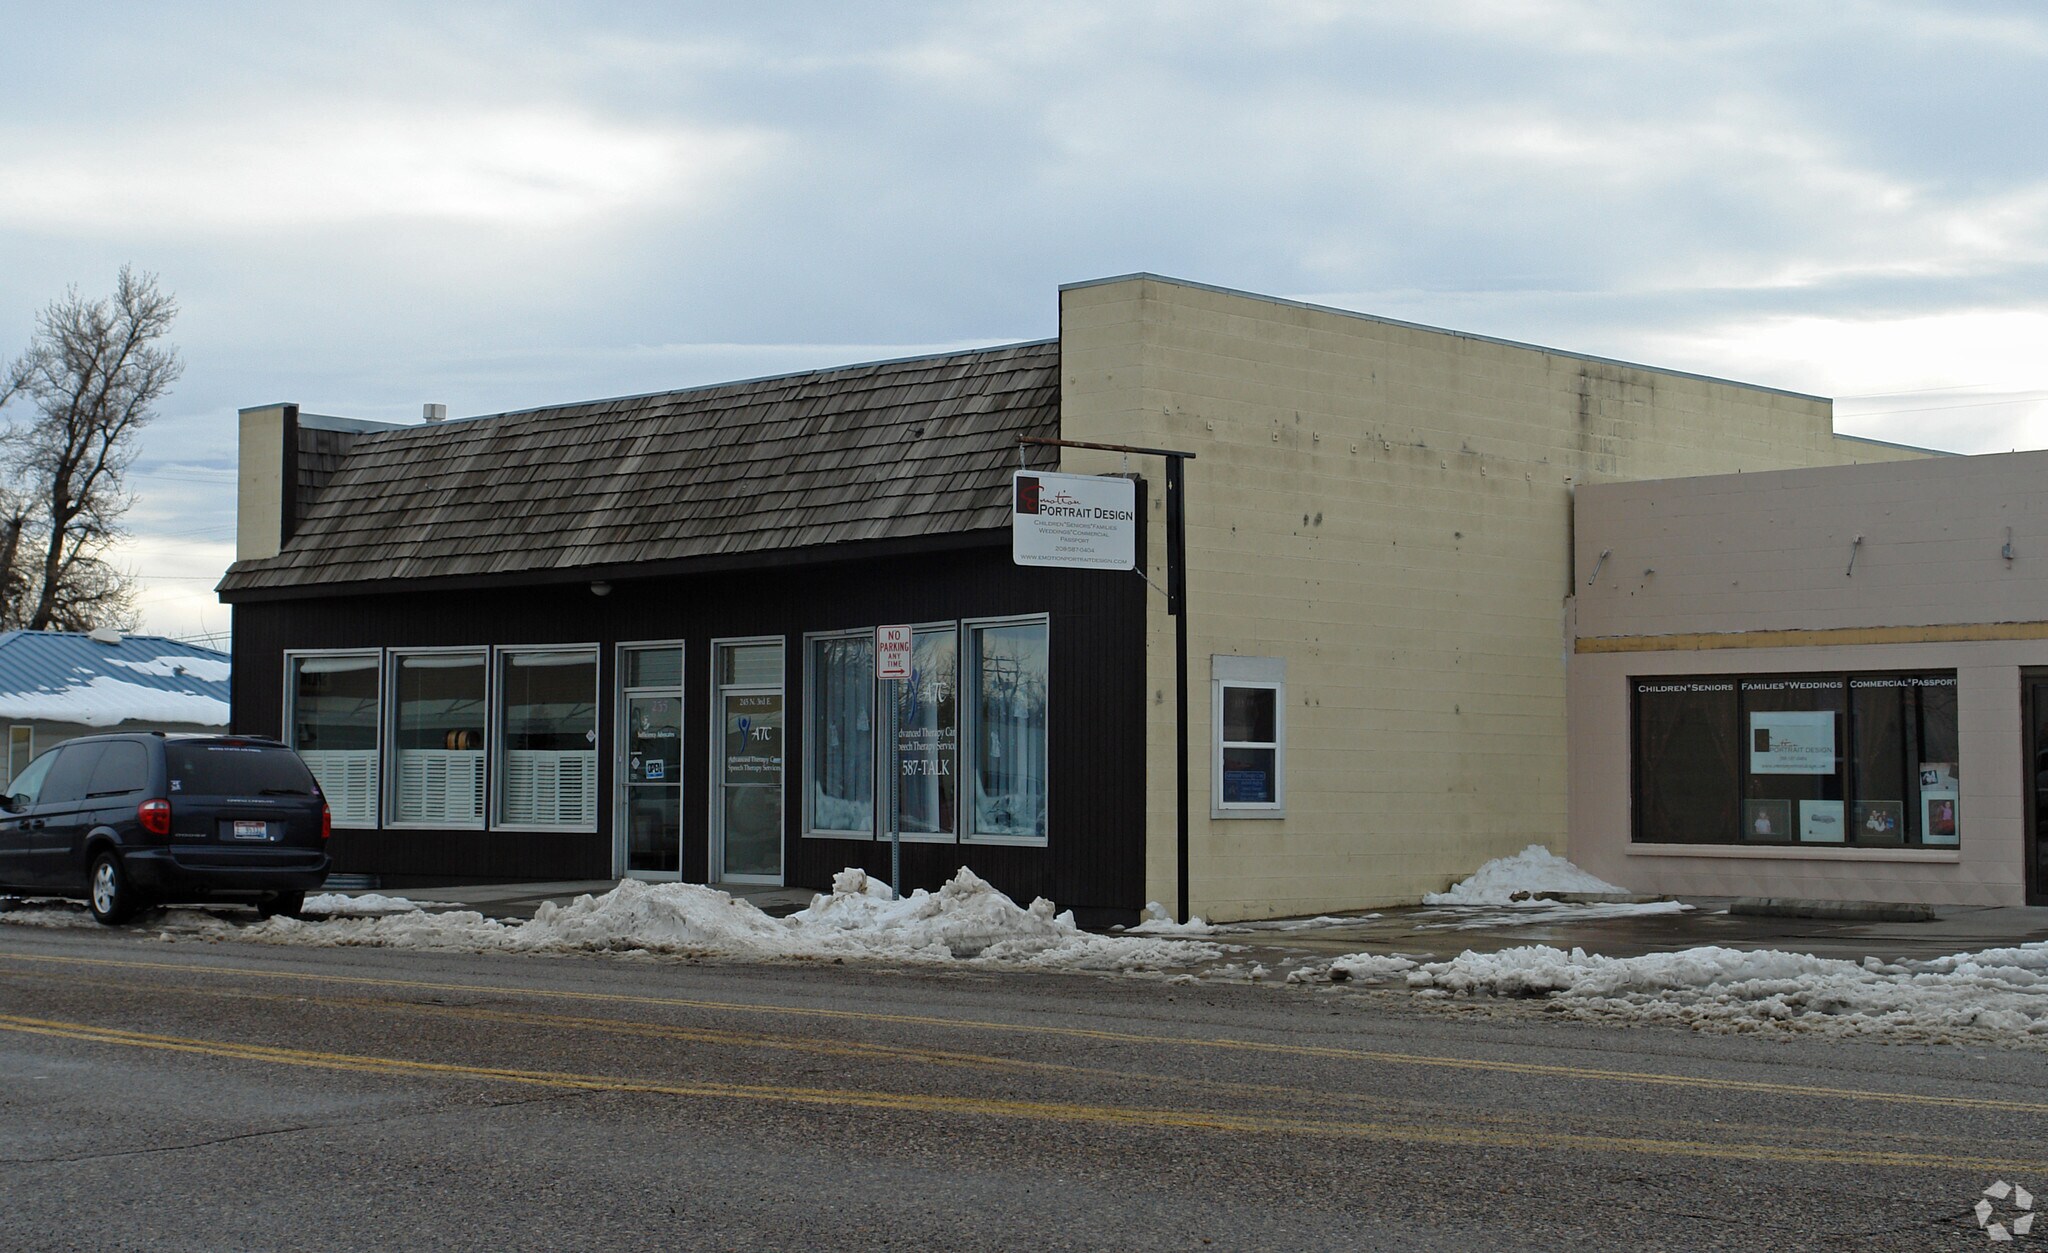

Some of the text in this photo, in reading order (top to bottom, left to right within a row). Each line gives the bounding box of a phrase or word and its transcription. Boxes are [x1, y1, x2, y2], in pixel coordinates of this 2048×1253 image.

[1040, 504, 1133, 521] PORTRAIT DESIGN
[888, 630, 901, 641] NO
[879, 641, 909, 653] PARKING
[888, 652, 901, 660] ANY
[887, 660, 903, 668] TIME
[898, 727, 921, 738] dvanced
[898, 741, 913, 751] peech
[647, 763, 663, 773] OPEN
[902, 759, 949, 776] 587-TALK
